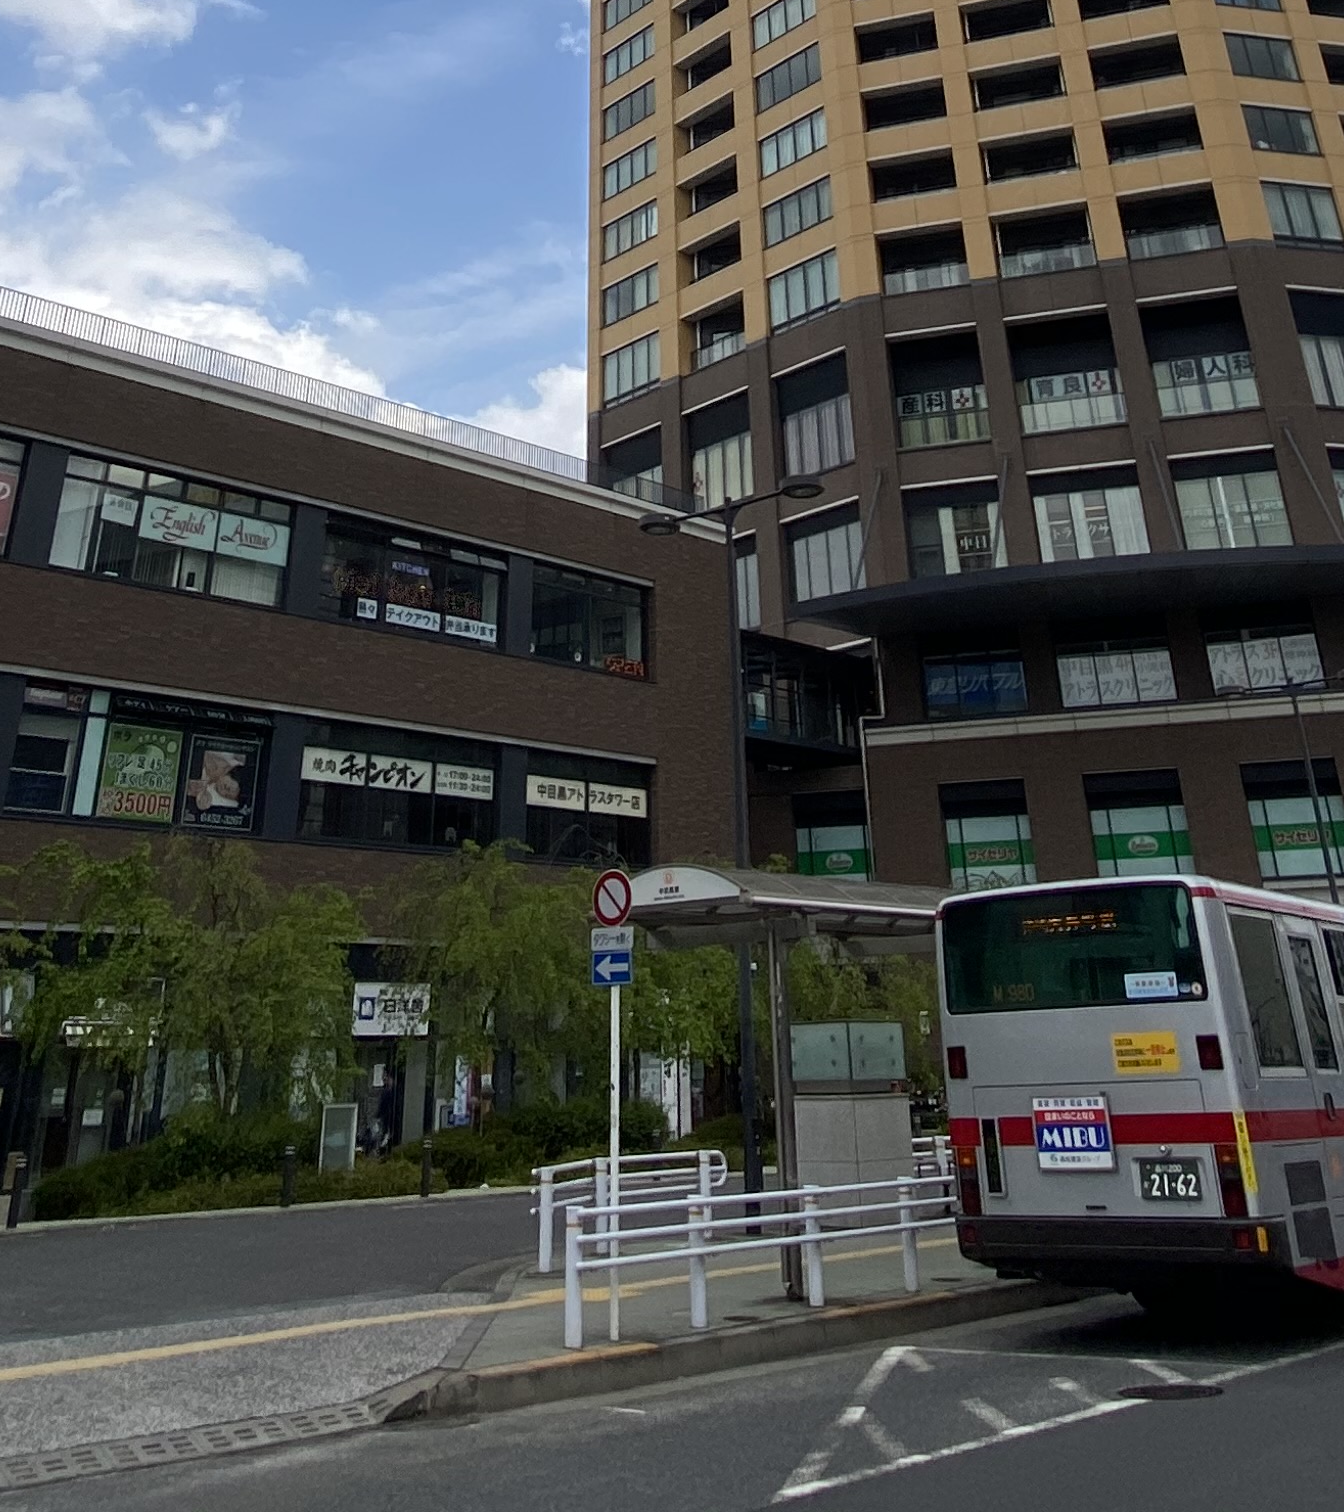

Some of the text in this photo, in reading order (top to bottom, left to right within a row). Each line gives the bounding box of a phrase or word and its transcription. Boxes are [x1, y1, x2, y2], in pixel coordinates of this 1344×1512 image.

[902, 391, 945, 415] 産科
[150, 506, 278, 550] English Avenue
[387, 607, 439, 626] テイクアウト
[446, 619, 496, 639] 弁当承ります
[339, 753, 427, 789] チャンピオン
[114, 791, 172, 816] 3500円
[537, 782, 641, 810] 中目黒アトラスタワー店
[1041, 1126, 1105, 1149] MIBU
